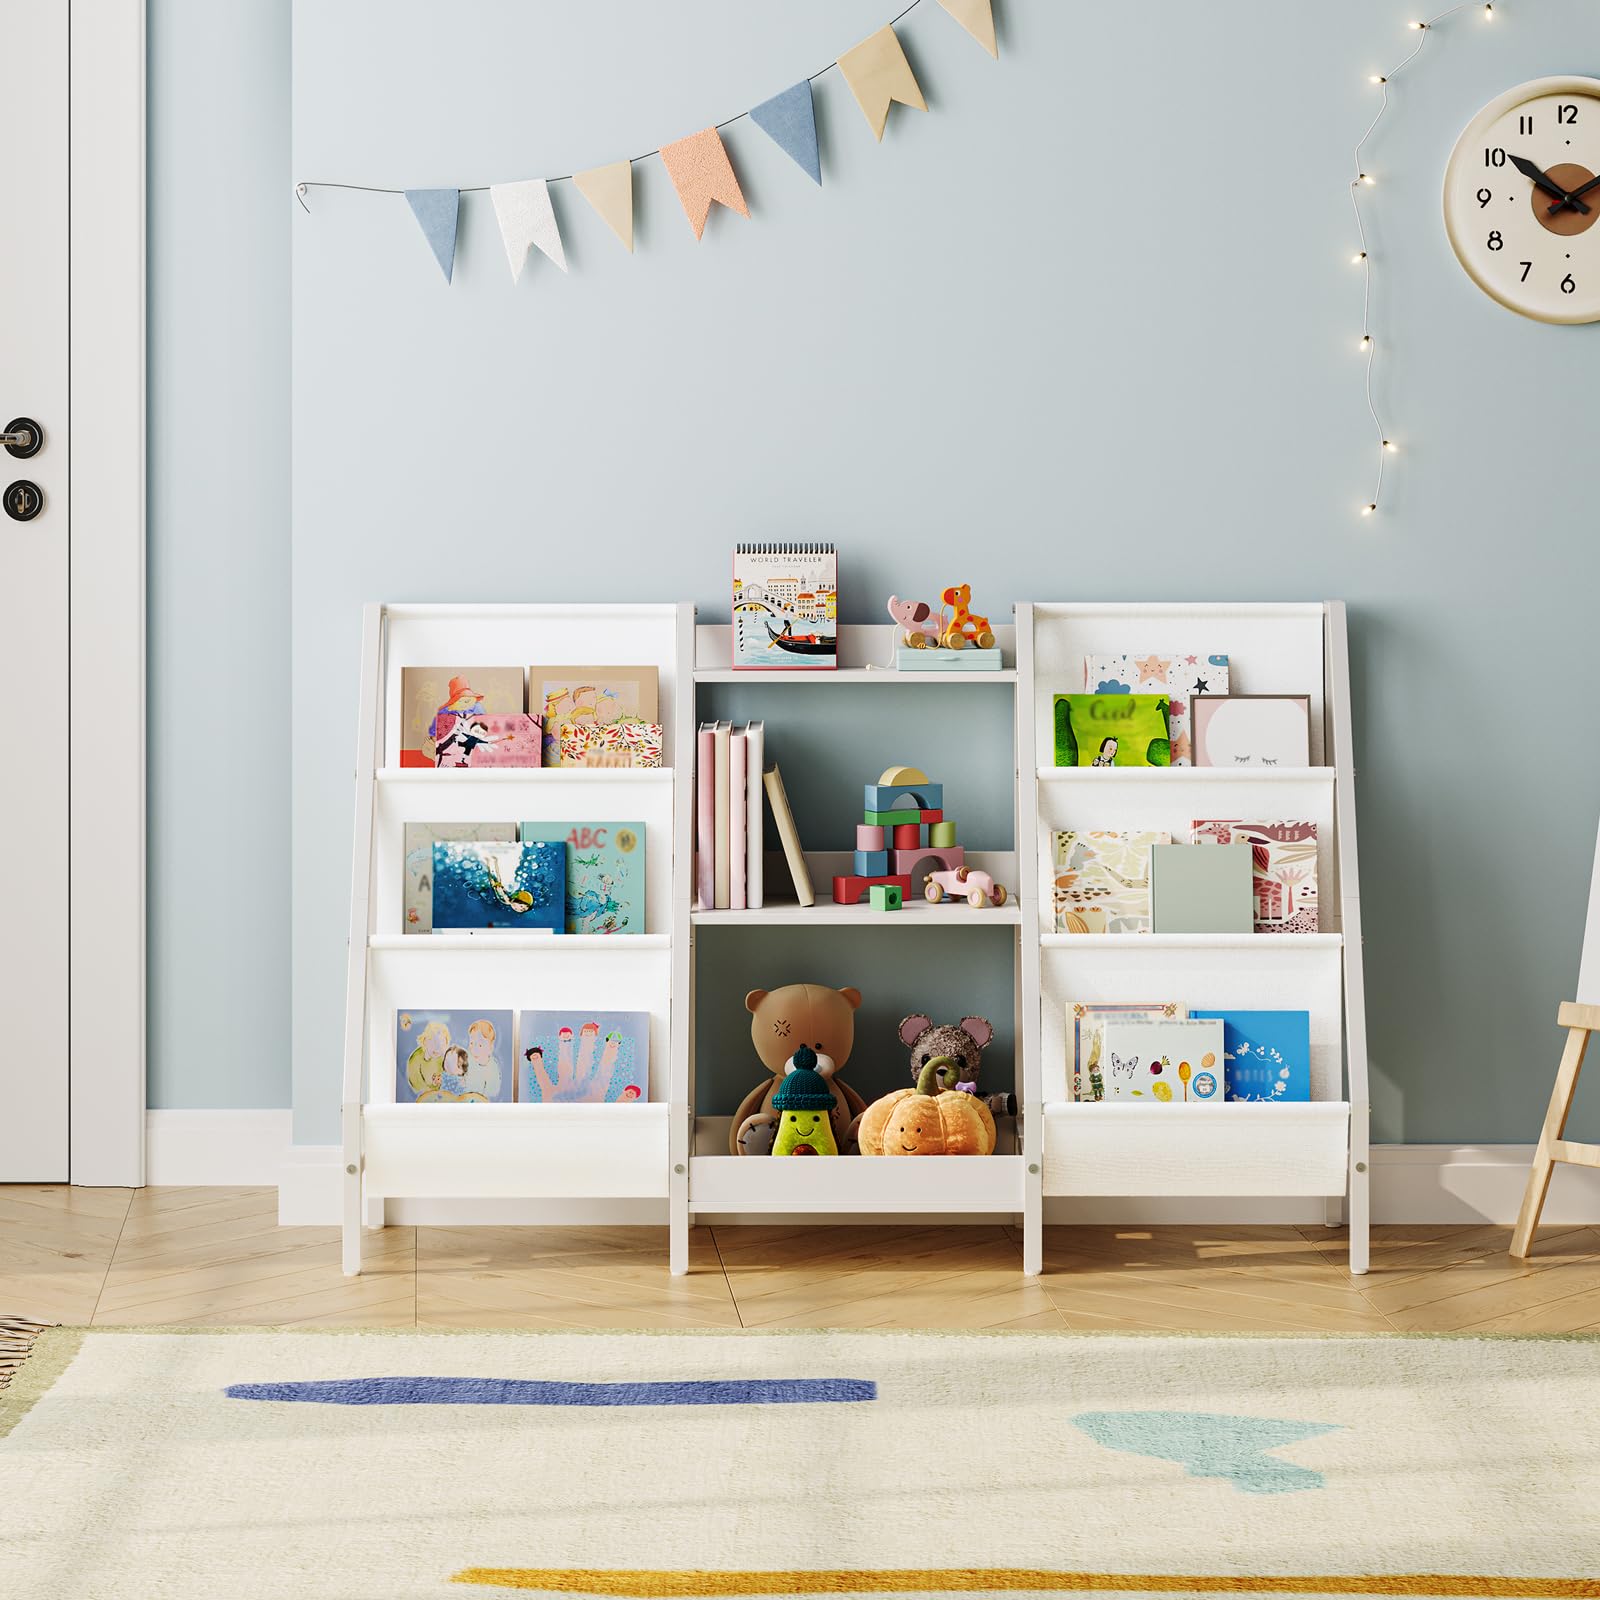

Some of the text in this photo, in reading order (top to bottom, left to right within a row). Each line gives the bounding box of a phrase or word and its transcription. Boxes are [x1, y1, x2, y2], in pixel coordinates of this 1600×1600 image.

[1558, 105, 1578, 124] 12
[1520, 116, 1532, 135] 11
[1485, 148, 1505, 167] 10
[1476, 188, 1492, 208] 9
[1487, 230, 1504, 251] 8
[1519, 262, 1532, 282] 7
[1560, 273, 1576, 294] 6
[566, 827, 607, 850] ABC
